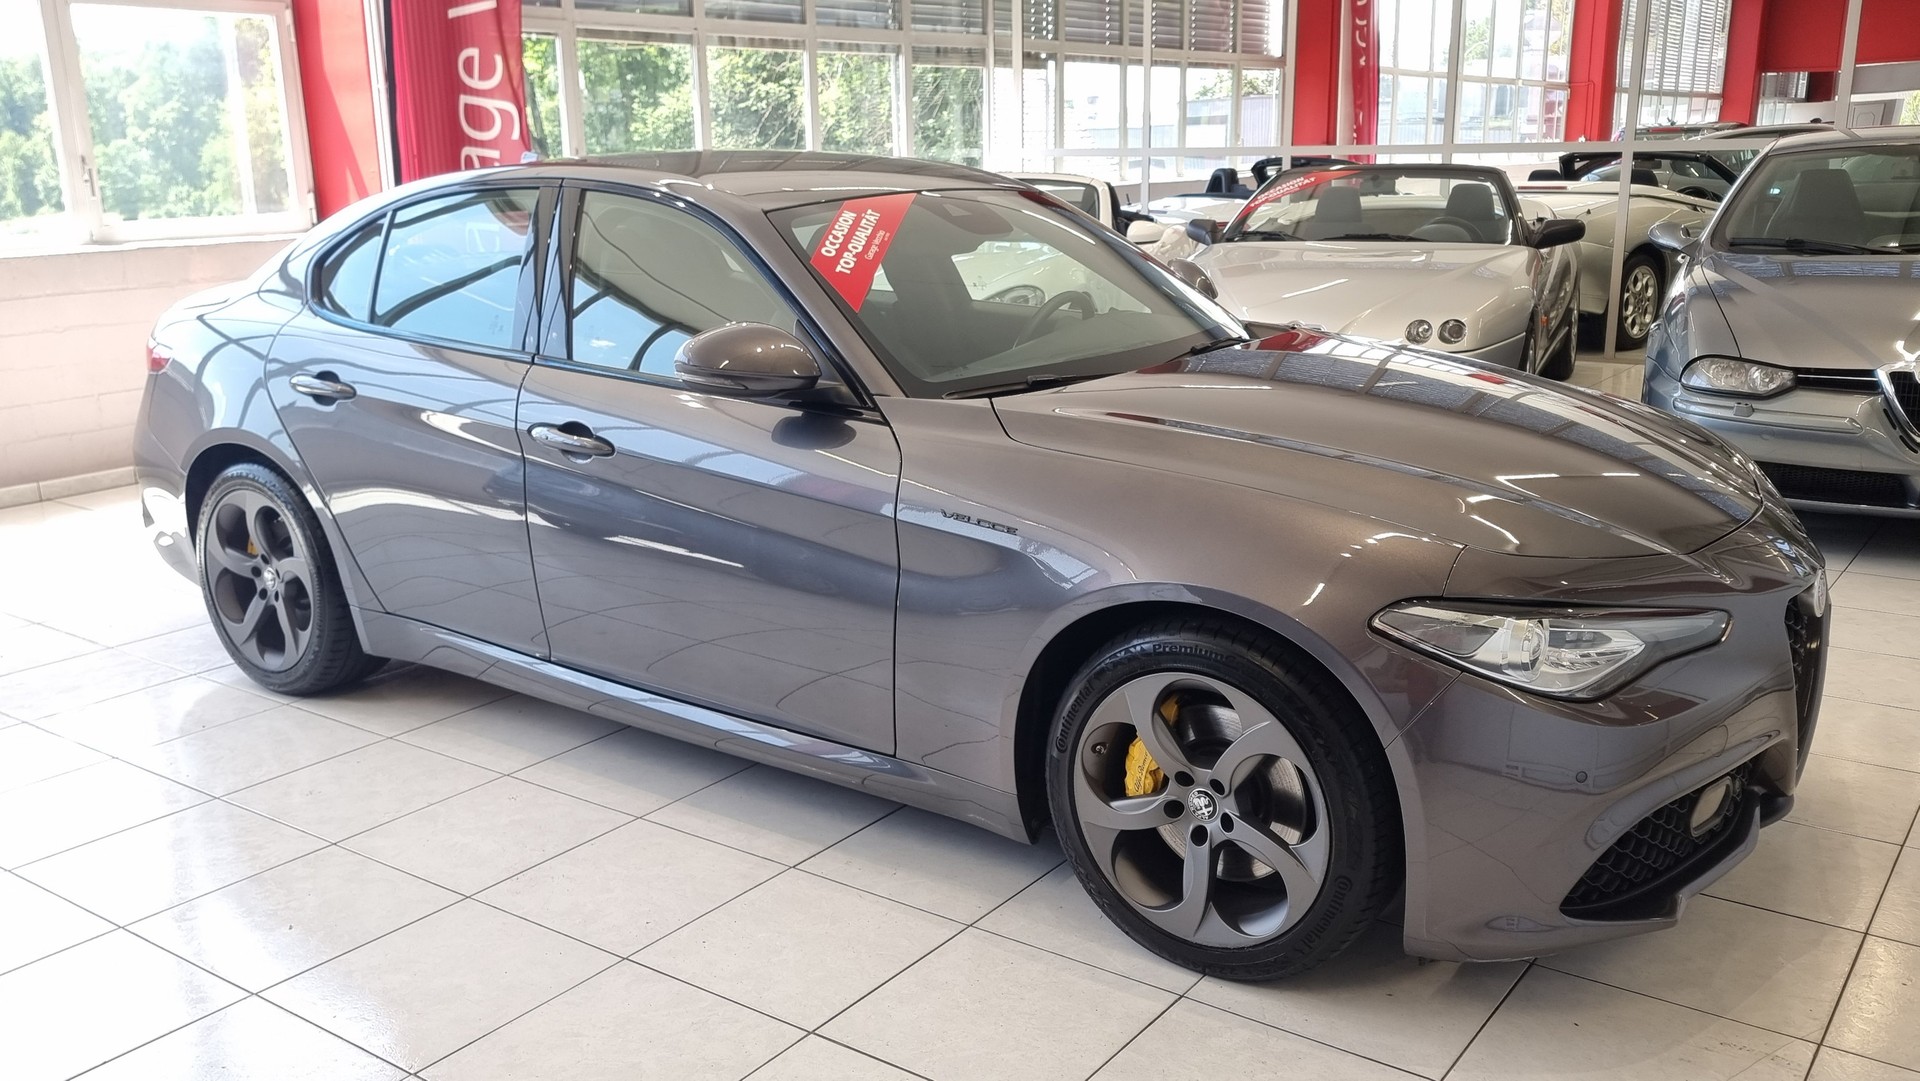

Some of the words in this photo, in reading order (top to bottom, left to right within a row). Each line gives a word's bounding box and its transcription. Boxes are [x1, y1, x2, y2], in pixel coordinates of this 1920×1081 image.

[1257, 176, 1305, 200] OCCASION
[820, 210, 858, 257] OCCASION
[835, 208, 881, 274] TOP-QUALITÄT
[940, 508, 1019, 536] VELOCE
[1055, 679, 1096, 754] Continental
[1300, 875, 1352, 949] Continental
